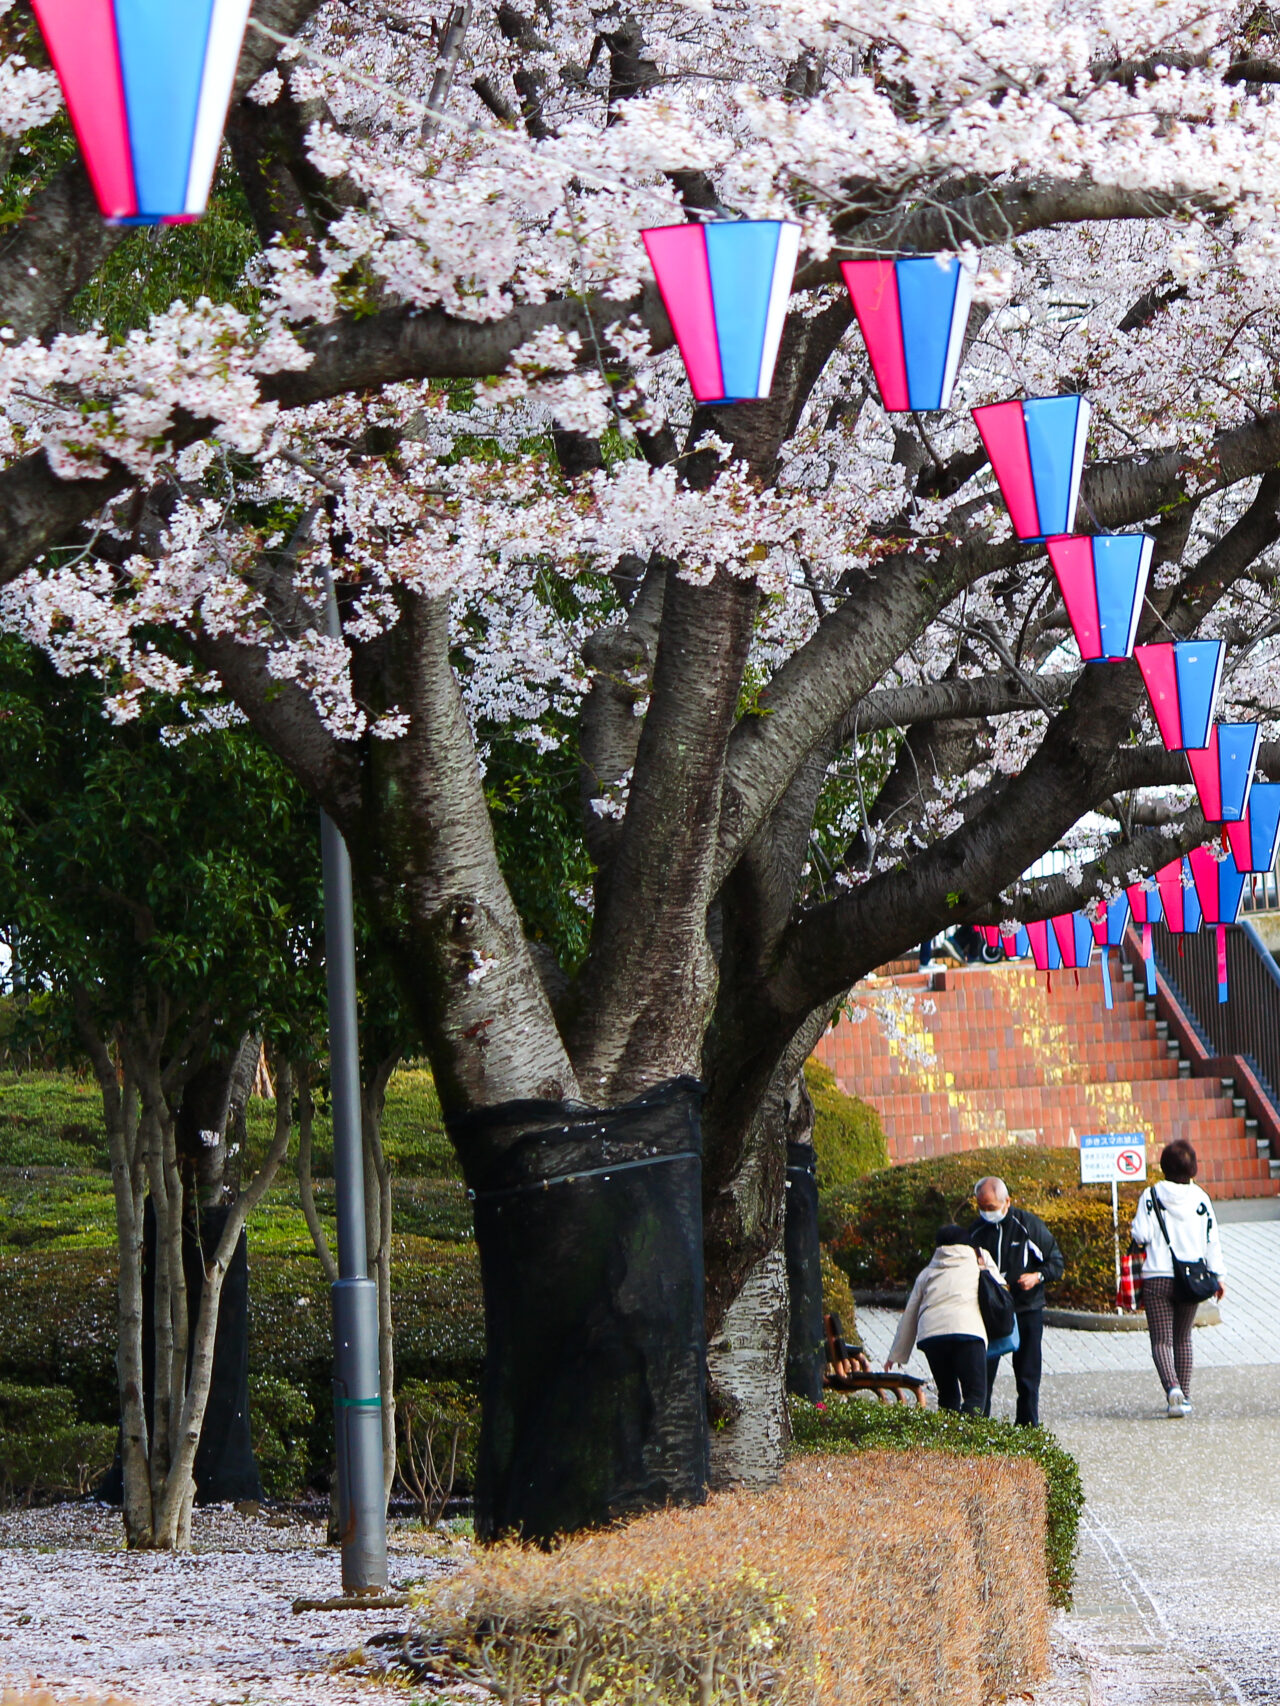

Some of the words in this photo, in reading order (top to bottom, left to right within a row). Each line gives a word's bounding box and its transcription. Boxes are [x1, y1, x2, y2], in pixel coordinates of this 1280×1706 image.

[1085, 1135, 1139, 1147] 歩きスマホ禁止
